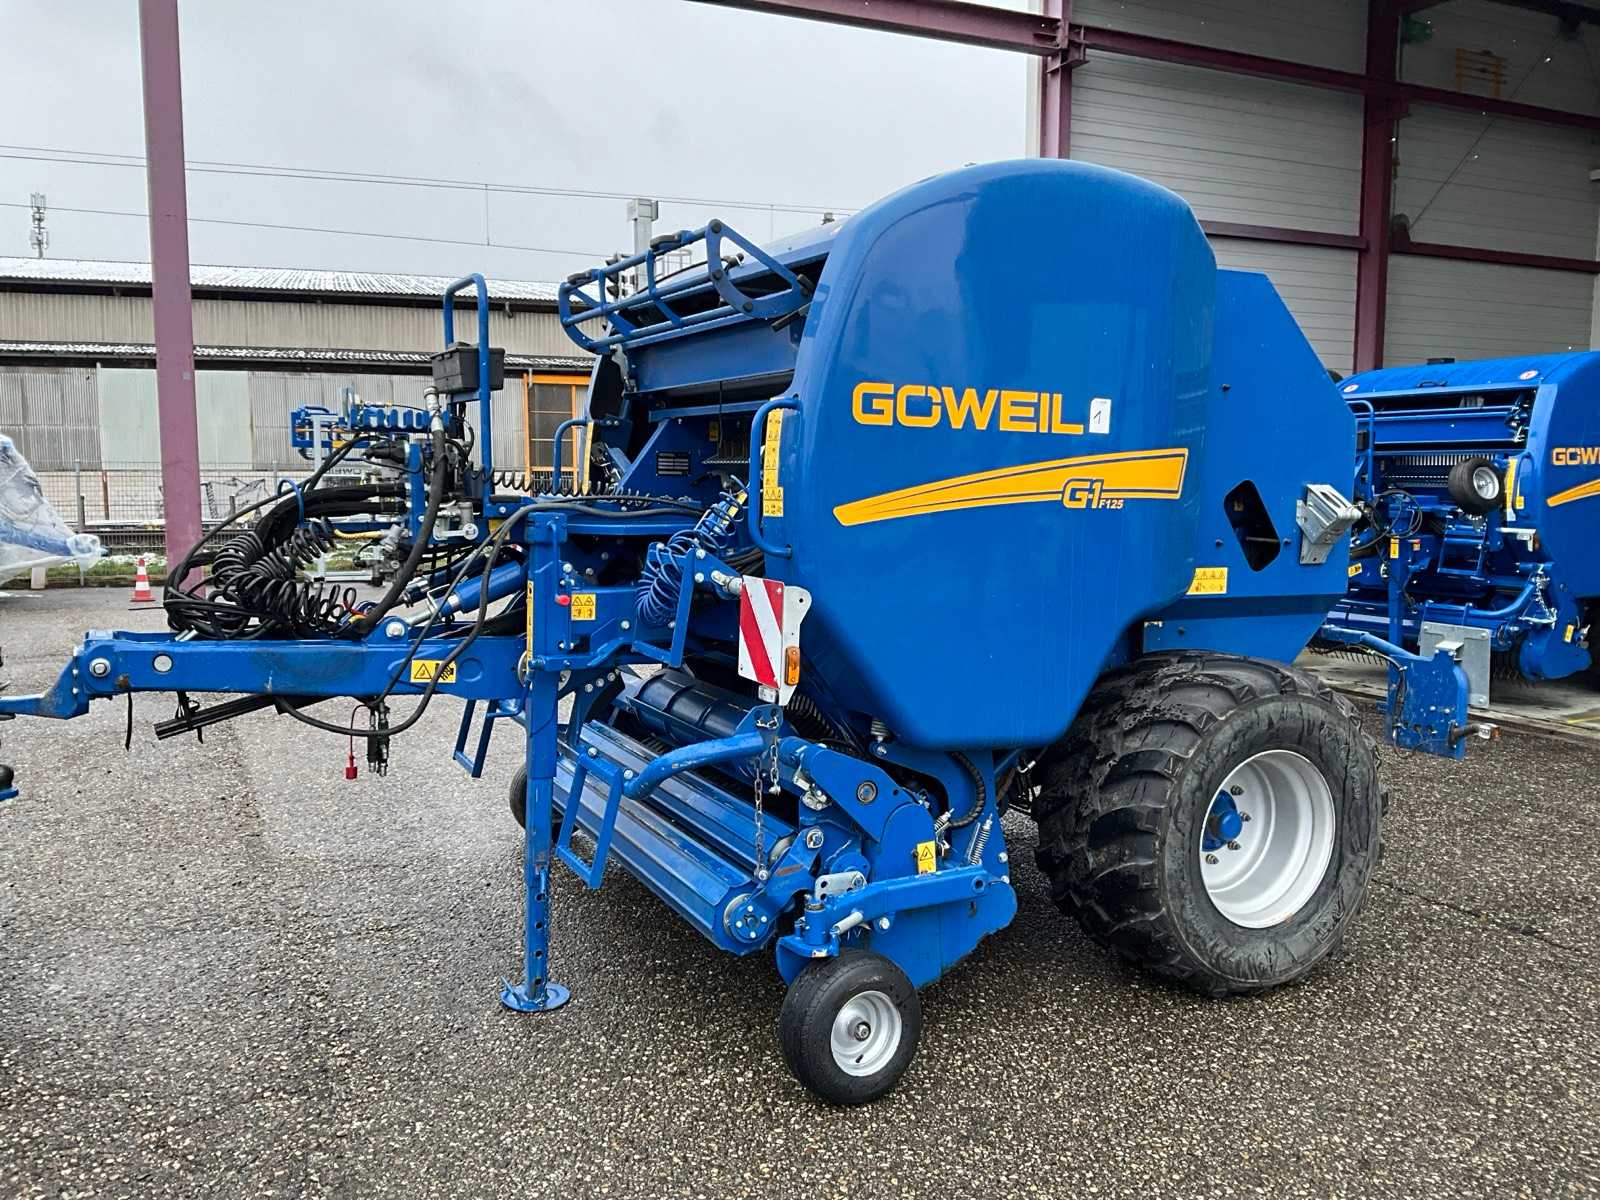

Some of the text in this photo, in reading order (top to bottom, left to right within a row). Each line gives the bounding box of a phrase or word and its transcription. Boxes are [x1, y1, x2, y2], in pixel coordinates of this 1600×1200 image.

[853, 382, 1084, 435] GOWEIL
[1552, 447, 1600, 466] GOW
[1098, 499, 1124, 510] F125
